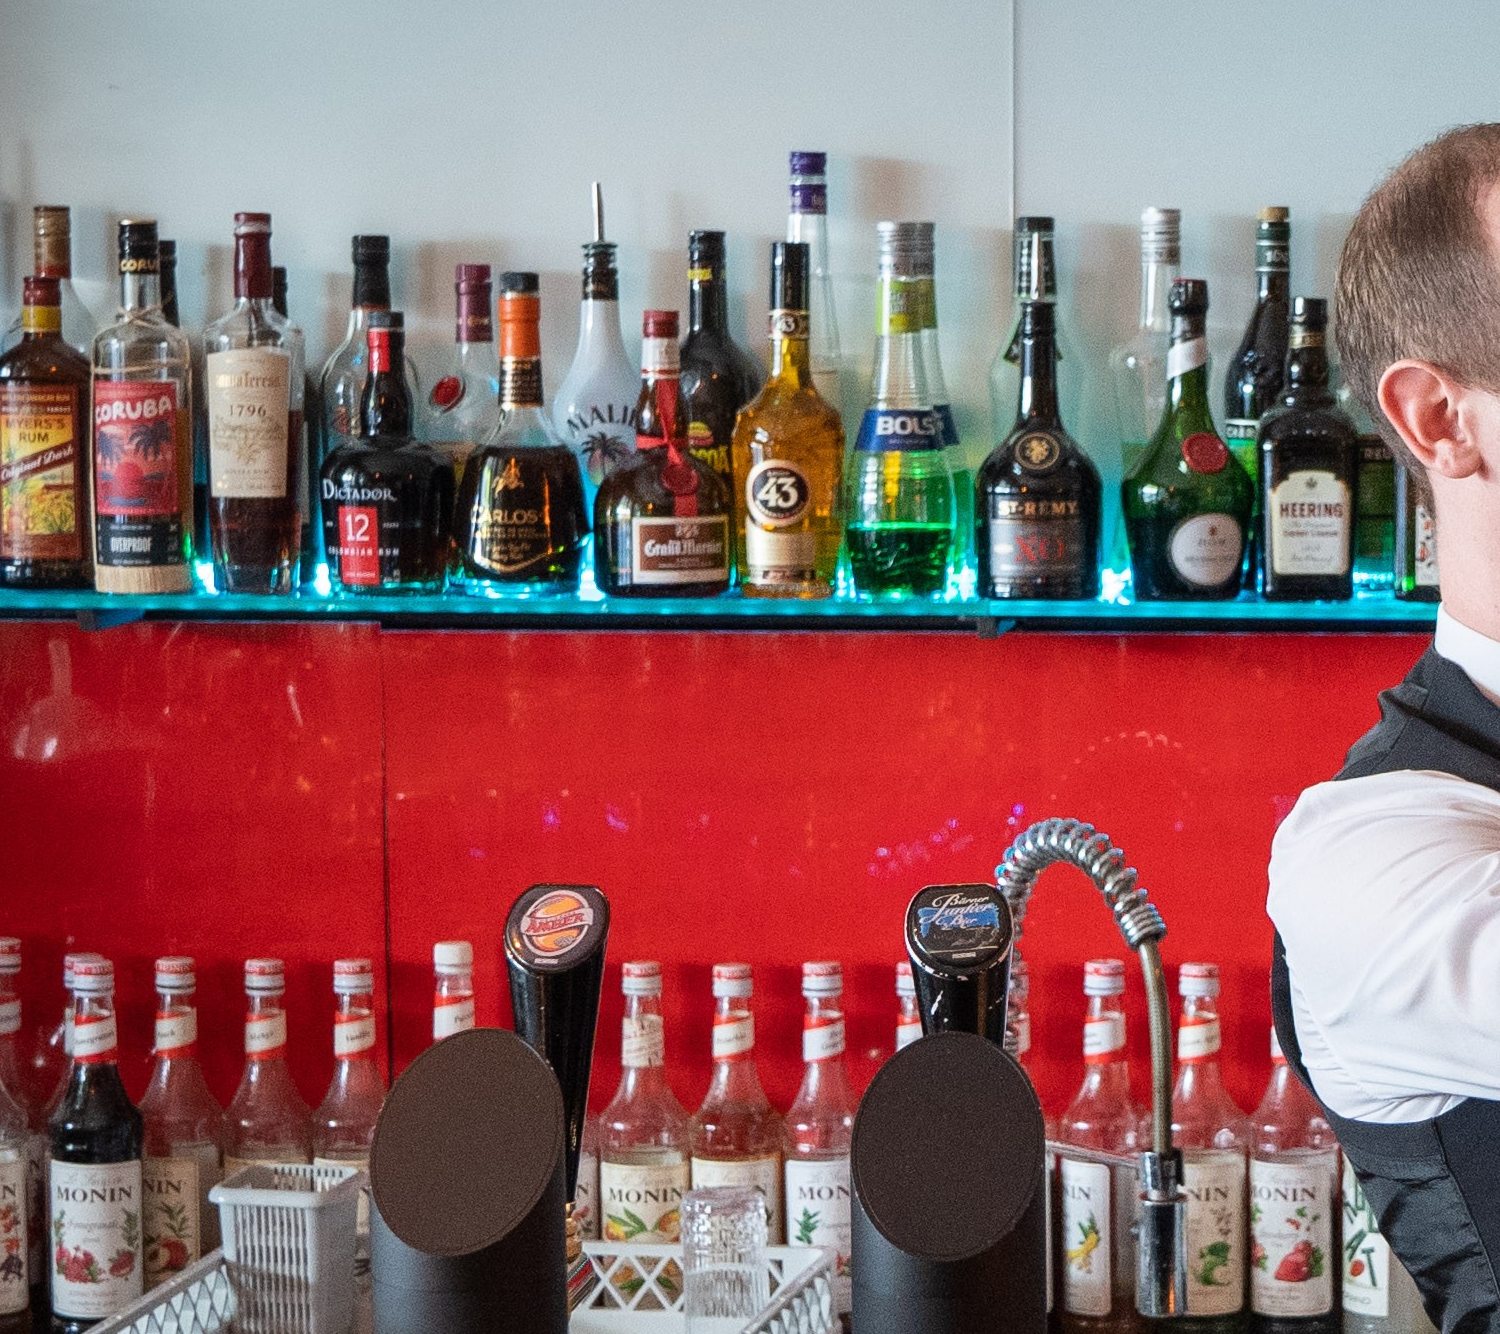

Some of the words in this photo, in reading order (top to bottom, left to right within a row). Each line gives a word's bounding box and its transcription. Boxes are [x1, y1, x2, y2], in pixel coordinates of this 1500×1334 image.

[229, 403, 267, 420] 1796
[876, 415, 937, 436] BOLS
[19, 432, 50, 445] RUM
[323, 478, 398, 503] DICTADOR
[755, 478, 799, 509] 43
[1280, 503, 1345, 518] HEERING
[344, 512, 370, 544] 12
[1013, 535, 1065, 564] XO
[56, 1185, 133, 1204] MONIN
